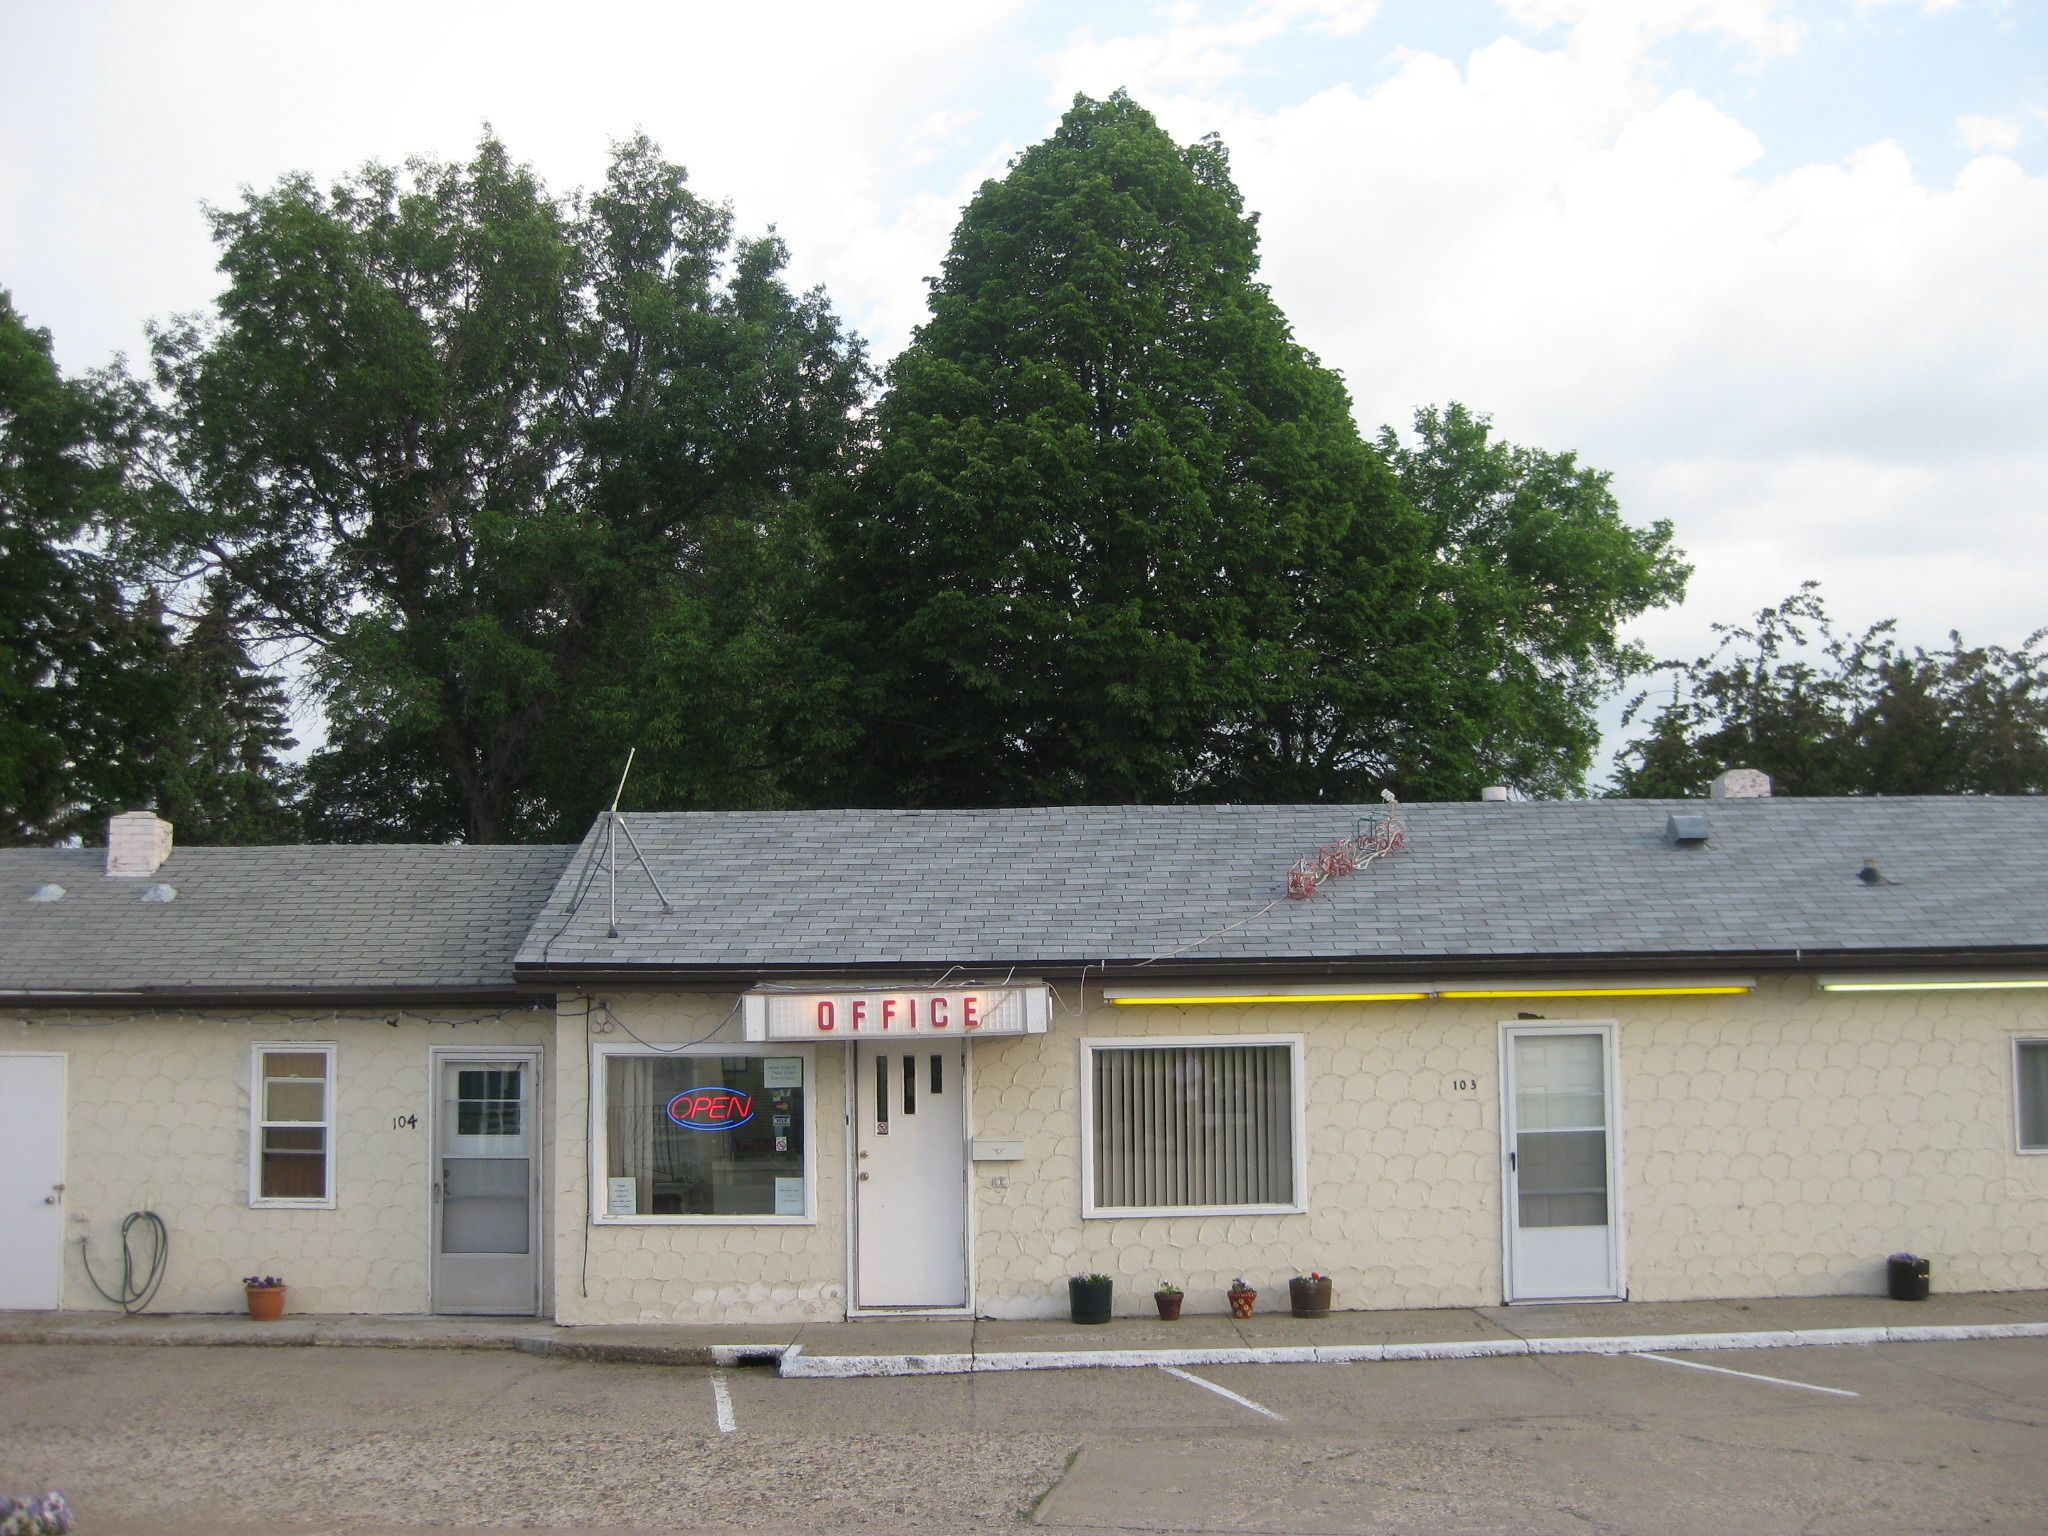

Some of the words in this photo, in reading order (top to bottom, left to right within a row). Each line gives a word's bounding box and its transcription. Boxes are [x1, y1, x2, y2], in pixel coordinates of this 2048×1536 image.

[817, 997, 979, 1031] OFFICE
[1453, 1079, 1477, 1091] 103
[670, 1096, 752, 1119] OPEN
[393, 1113, 418, 1131] 104
